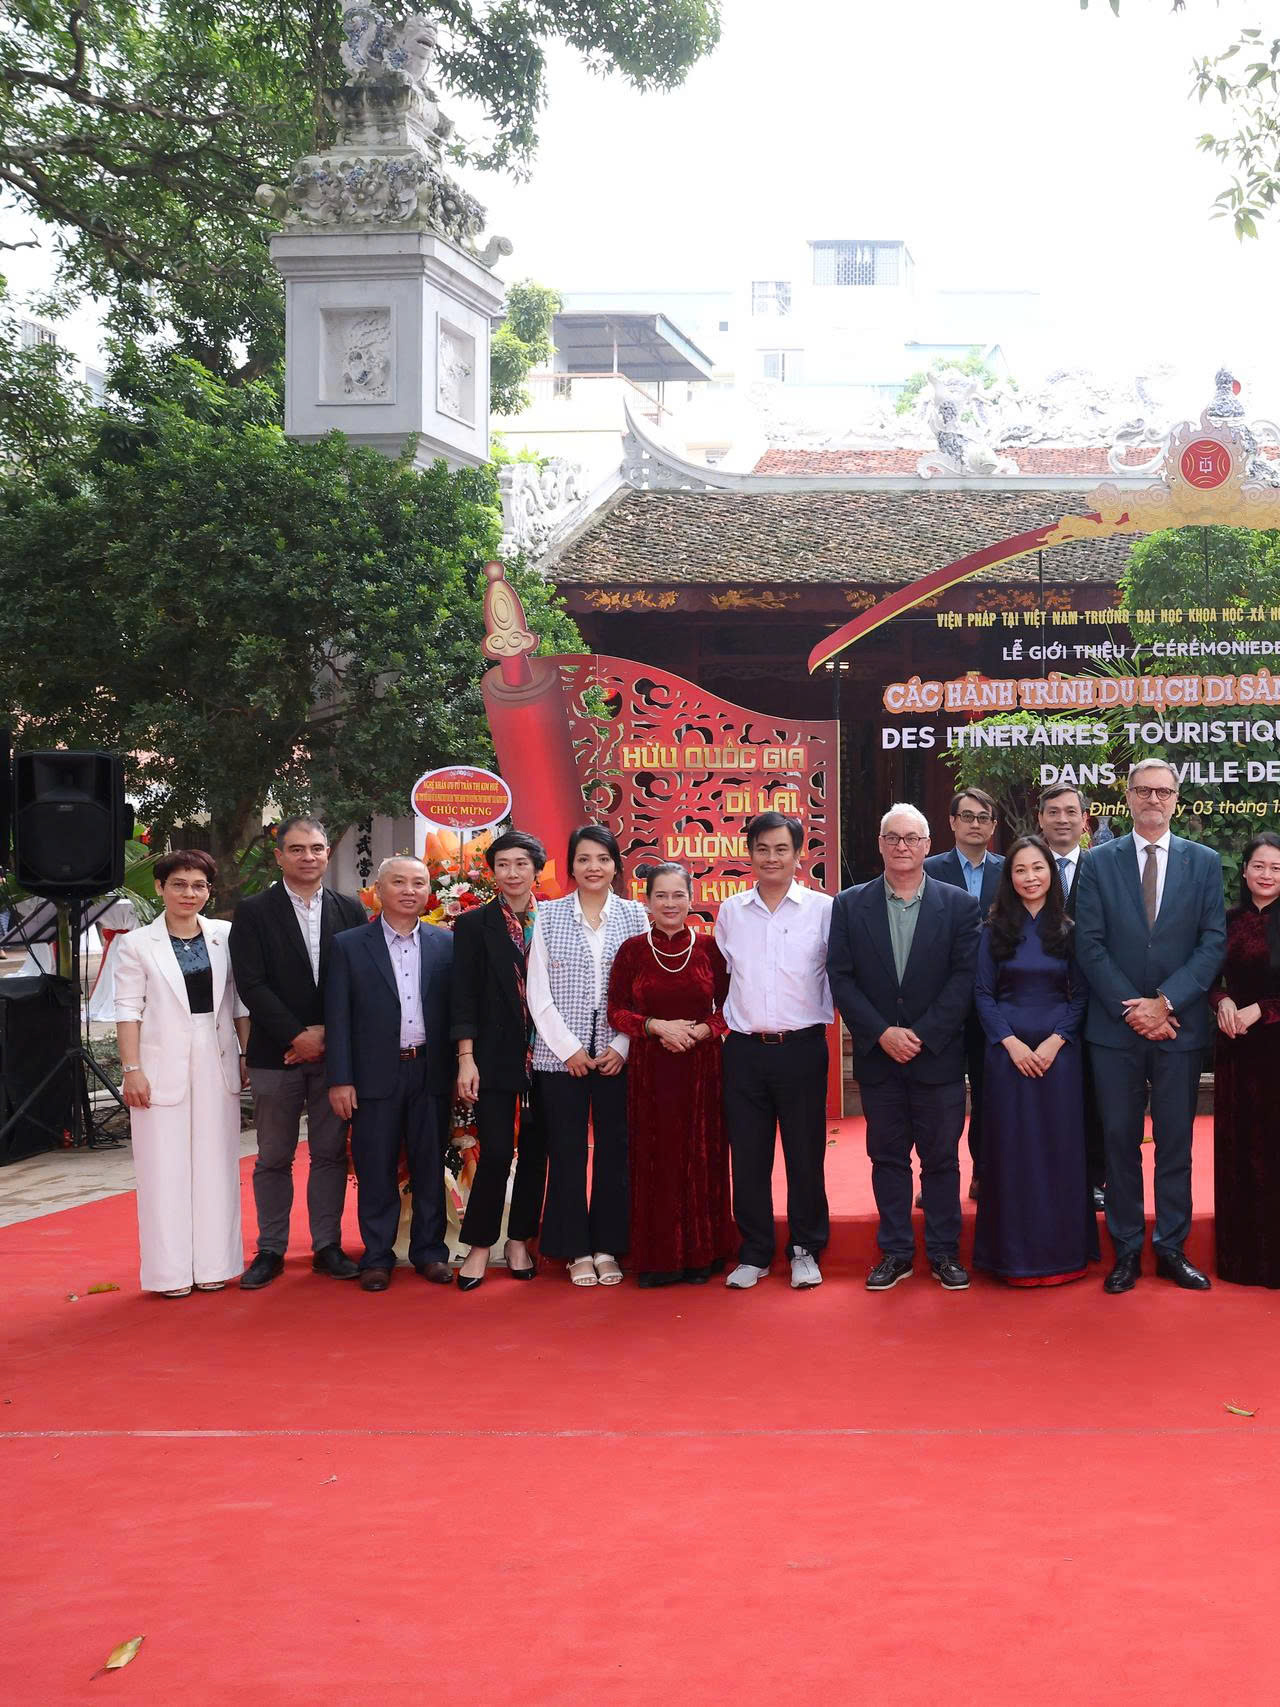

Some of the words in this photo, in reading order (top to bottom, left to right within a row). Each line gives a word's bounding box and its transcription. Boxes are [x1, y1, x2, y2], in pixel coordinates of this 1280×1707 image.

[937, 611, 962, 630] VIỆN
[968, 610, 996, 627] PHÁP
[1002, 612, 1019, 628] TẠI
[1024, 609, 1046, 628] VIỆT
[1136, 608, 1154, 625] ĐẠI
[1160, 608, 1182, 626] HỌC
[1188, 608, 1216, 623] KHOA
[1222, 608, 1244, 626] HỌC
[1002, 638, 1022, 660] LỄ
[1029, 641, 1067, 660] GIỚI
[1073, 640, 1126, 662] THIỆU
[1131, 644, 1141, 660] /
[887, 679, 939, 708] CÁC
[947, 676, 1013, 707] HÀNH
[1020, 674, 1094, 706] TRÌNH
[1100, 679, 1134, 703] DU
[1142, 678, 1198, 708] LỊCH
[1206, 678, 1233, 702] DI
[882, 726, 935, 749] DES
[947, 723, 1108, 748] ITINERAIRES
[623, 741, 678, 768] HỮU
[685, 737, 756, 768] QUỐC
[763, 748, 804, 768] GIA
[1040, 763, 1116, 786] DANS
[1177, 762, 1239, 784] VILLE
[430, 804, 458, 814] CHÚC
[460, 804, 492, 816] MỪNG
[1192, 800, 1214, 815] 03
[1220, 799, 1268, 816] tháng
